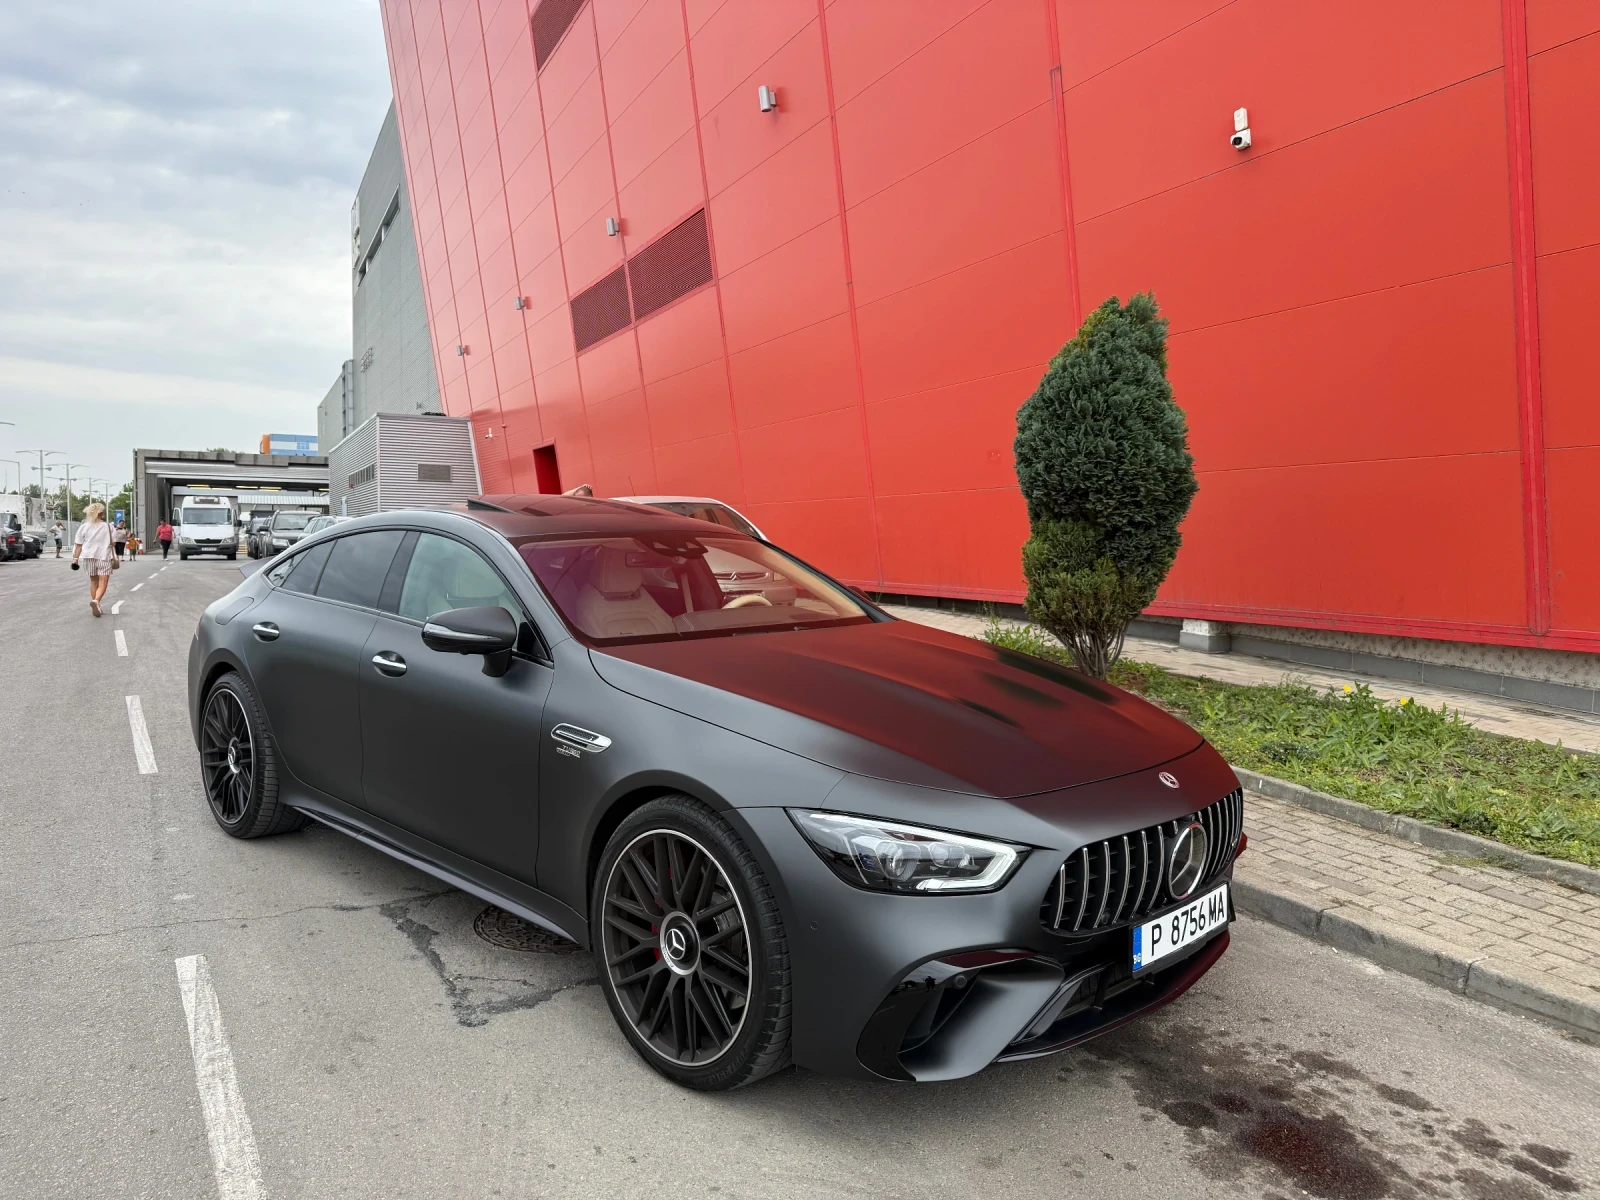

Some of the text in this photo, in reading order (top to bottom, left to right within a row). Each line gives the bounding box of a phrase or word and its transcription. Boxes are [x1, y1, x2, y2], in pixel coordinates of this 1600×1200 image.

[1151, 891, 1225, 956] P 8756 MA
